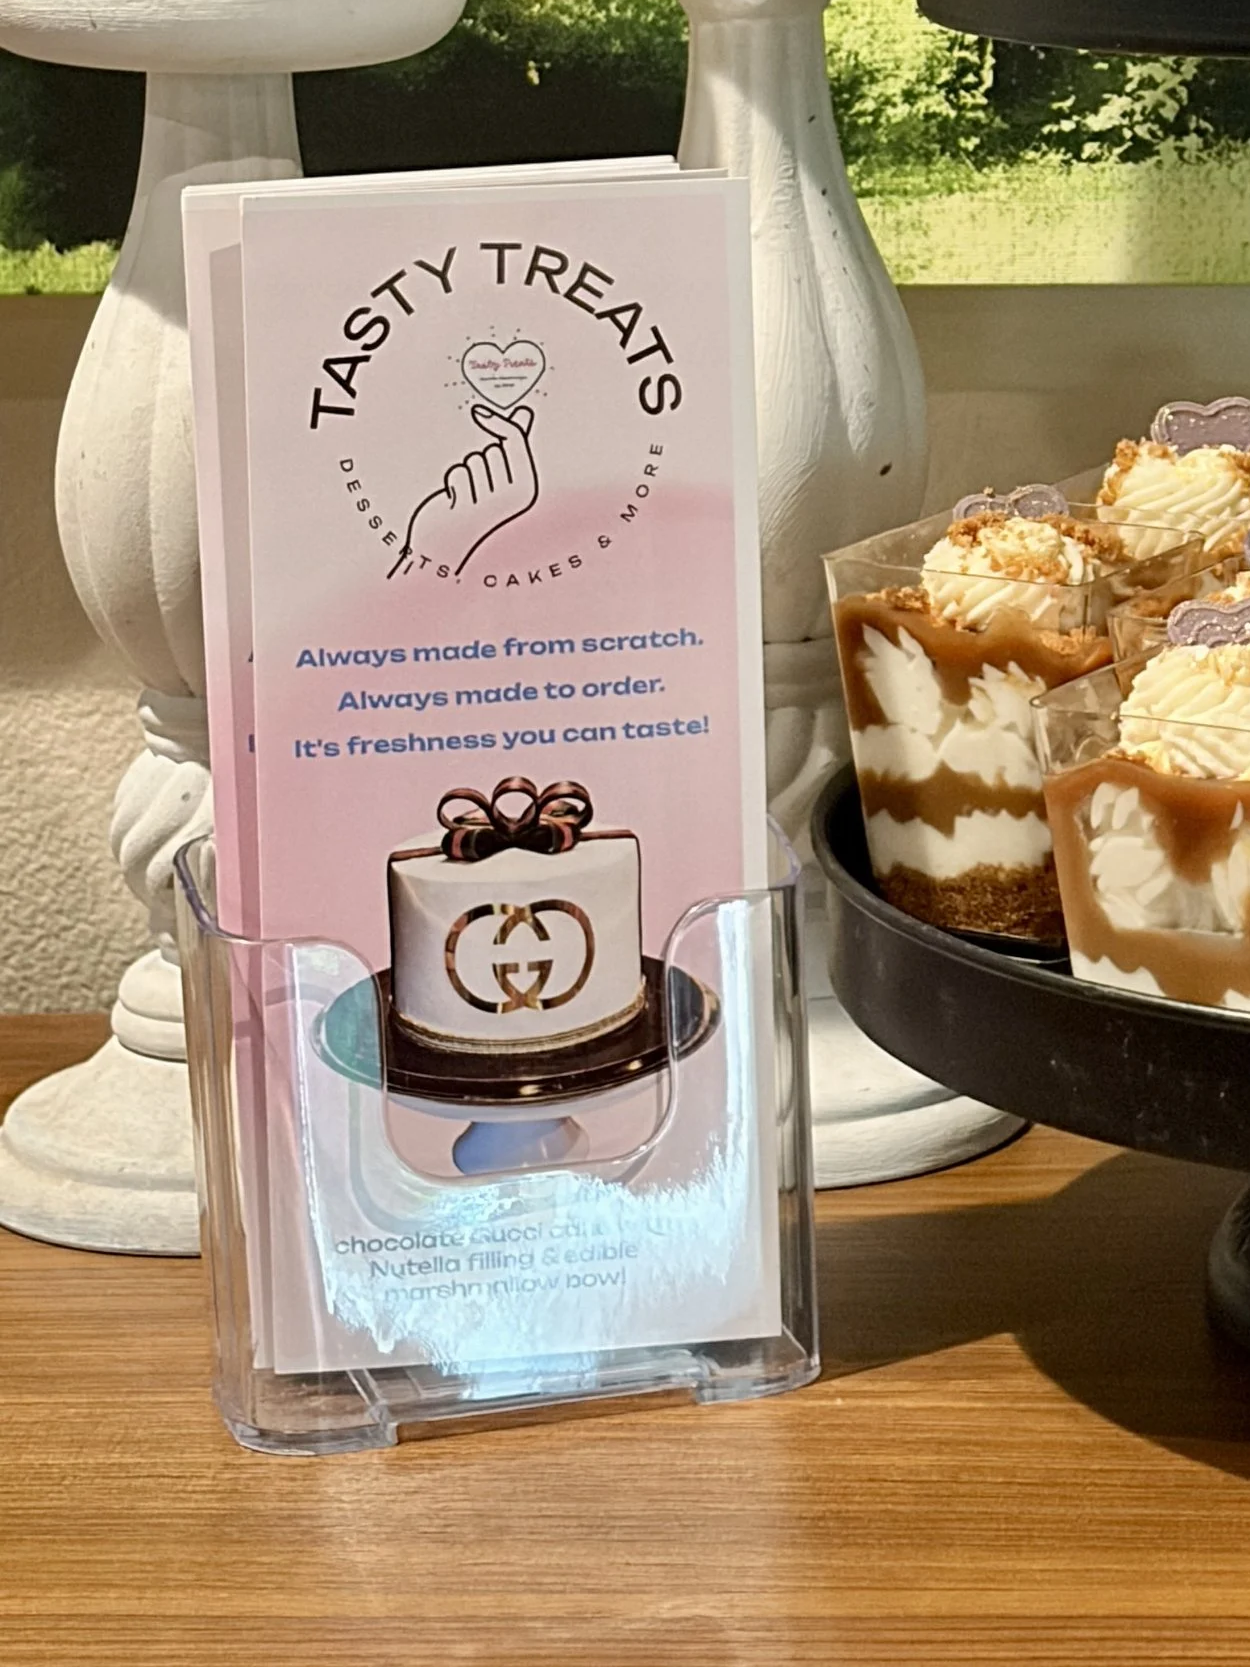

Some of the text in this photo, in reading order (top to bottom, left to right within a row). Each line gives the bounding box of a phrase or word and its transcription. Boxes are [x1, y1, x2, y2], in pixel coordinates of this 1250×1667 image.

[310, 242, 683, 430] TASTY TREATS
[483, 554, 583, 588] CAKES
[597, 534, 612, 549] &
[619, 443, 664, 523] MORE
[295, 628, 705, 669] Always made from scratch.
[337, 675, 666, 712] Always made to order.
[294, 716, 710, 759] It's freshness you can taste!
[334, 1230, 465, 1255] chocolate
[369, 1253, 461, 1279] Nutella
[468, 1250, 536, 1271] filling
[564, 1240, 639, 1264] edible
